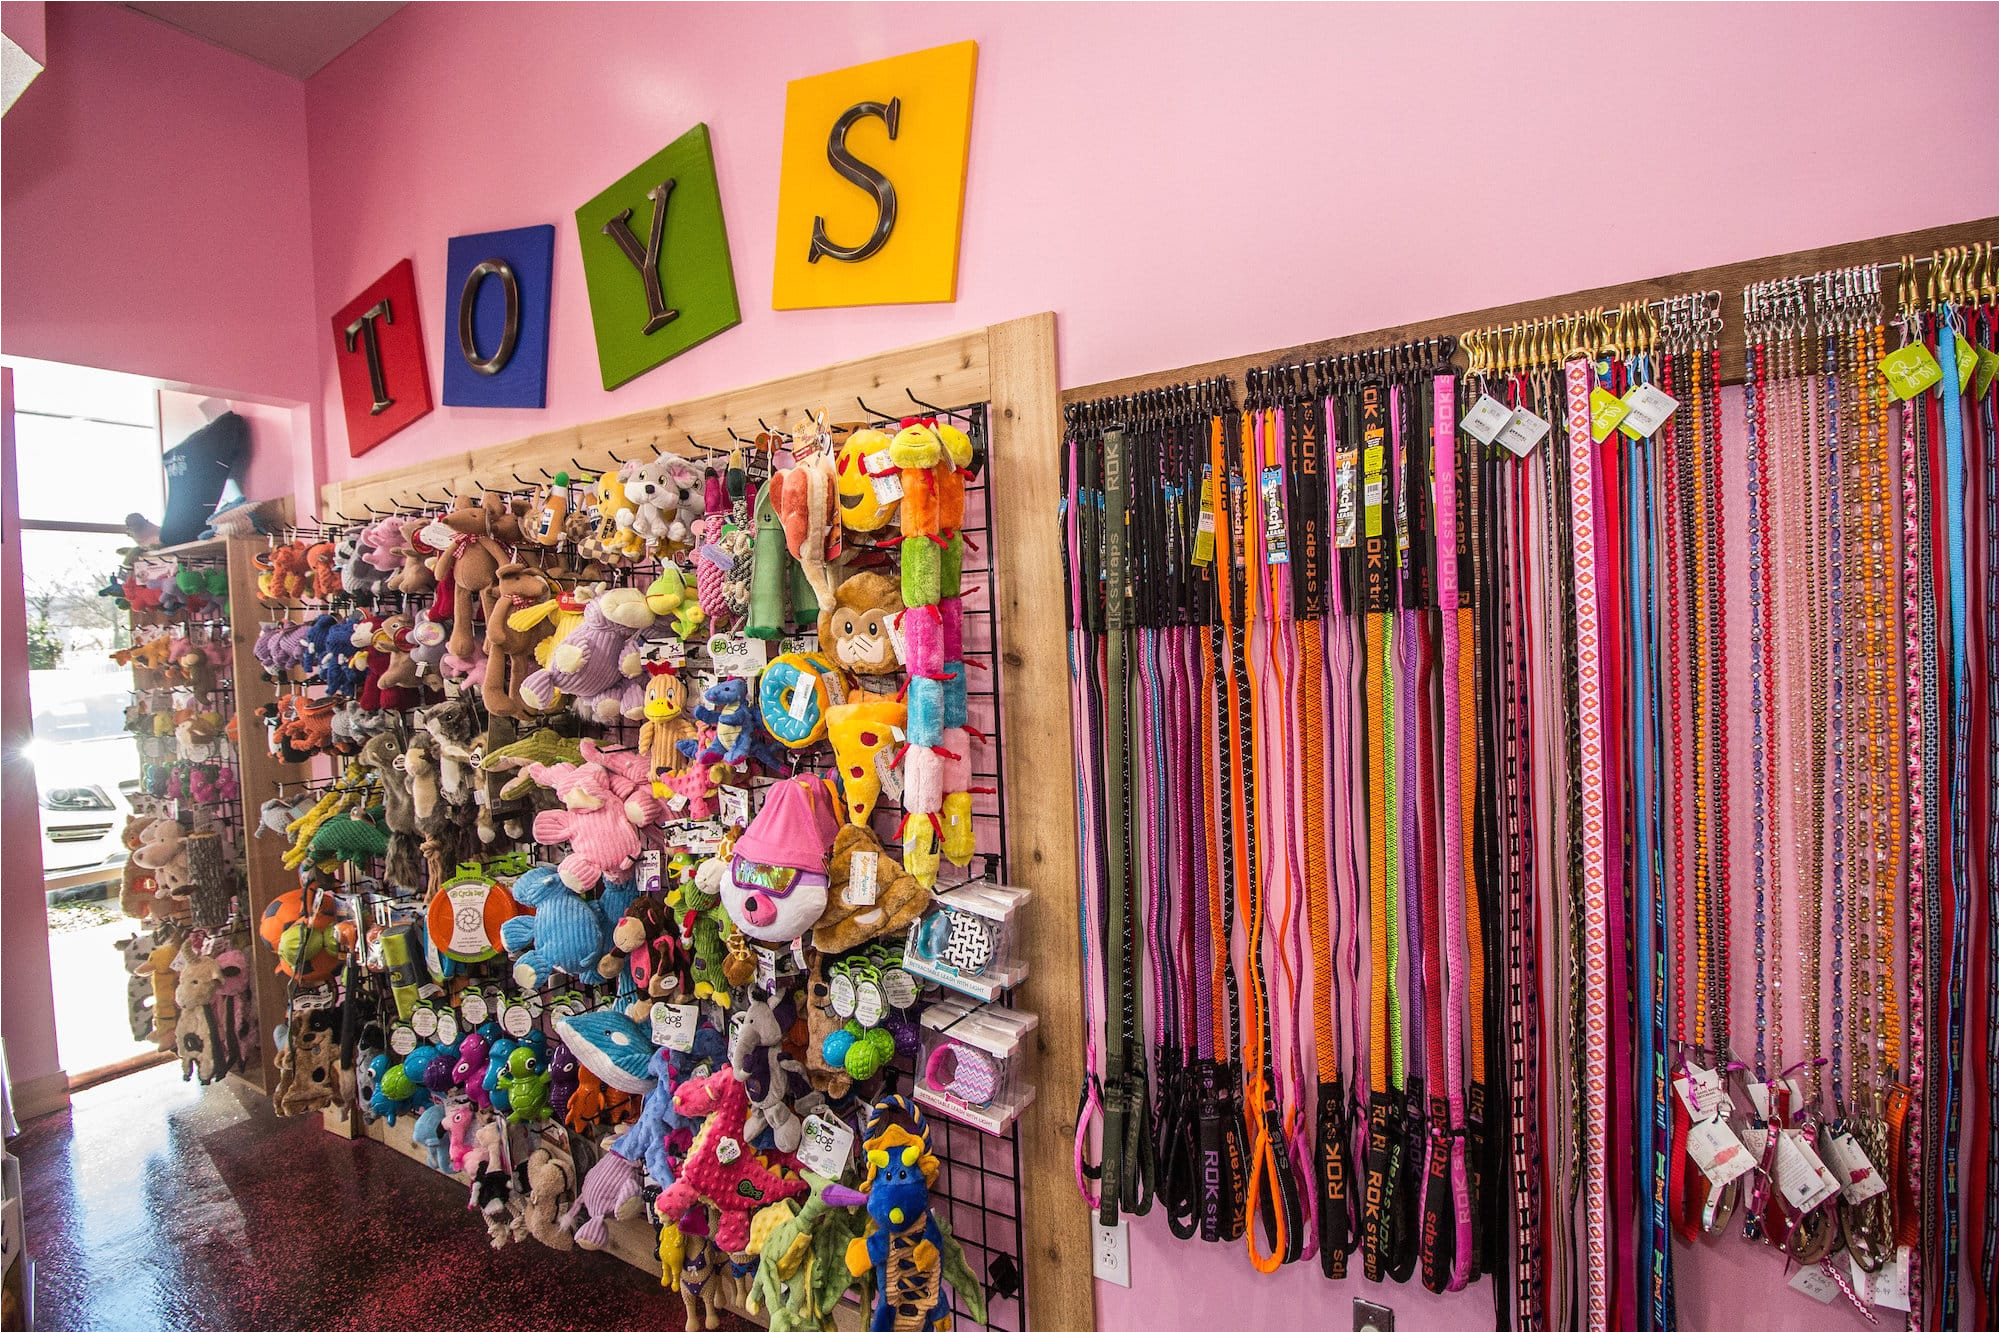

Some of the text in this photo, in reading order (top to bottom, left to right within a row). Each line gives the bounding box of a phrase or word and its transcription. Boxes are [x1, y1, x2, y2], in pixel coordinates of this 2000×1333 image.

[1106, 443, 1120, 491] ROK
[1303, 424, 1318, 475] ROK
[1267, 480, 1282, 530] Stretch
[1338, 460, 1352, 513] Stretch
[1441, 473, 1458, 590] ROK straps
[1456, 488, 1467, 556] straps
[1109, 532, 1122, 599] straps
[1306, 520, 1318, 593] straps
[1366, 538, 1382, 569] OK
[956, 978, 969, 988] WITH
[969, 983, 985, 993] LIGHT
[1271, 1129, 1290, 1170] aps
[1325, 1142, 1345, 1200] ROK
[1204, 1151, 1219, 1241] ROK stra
[1226, 1131, 1246, 1238] OK straps
[1365, 1170, 1383, 1220] ROK
[1380, 1144, 1401, 1257] ROK straps
[1455, 1174, 1471, 1224] ROK
[1331, 1249, 1345, 1280] aps
[1365, 1222, 1379, 1281] straps
[1422, 1210, 1438, 1276] straps
